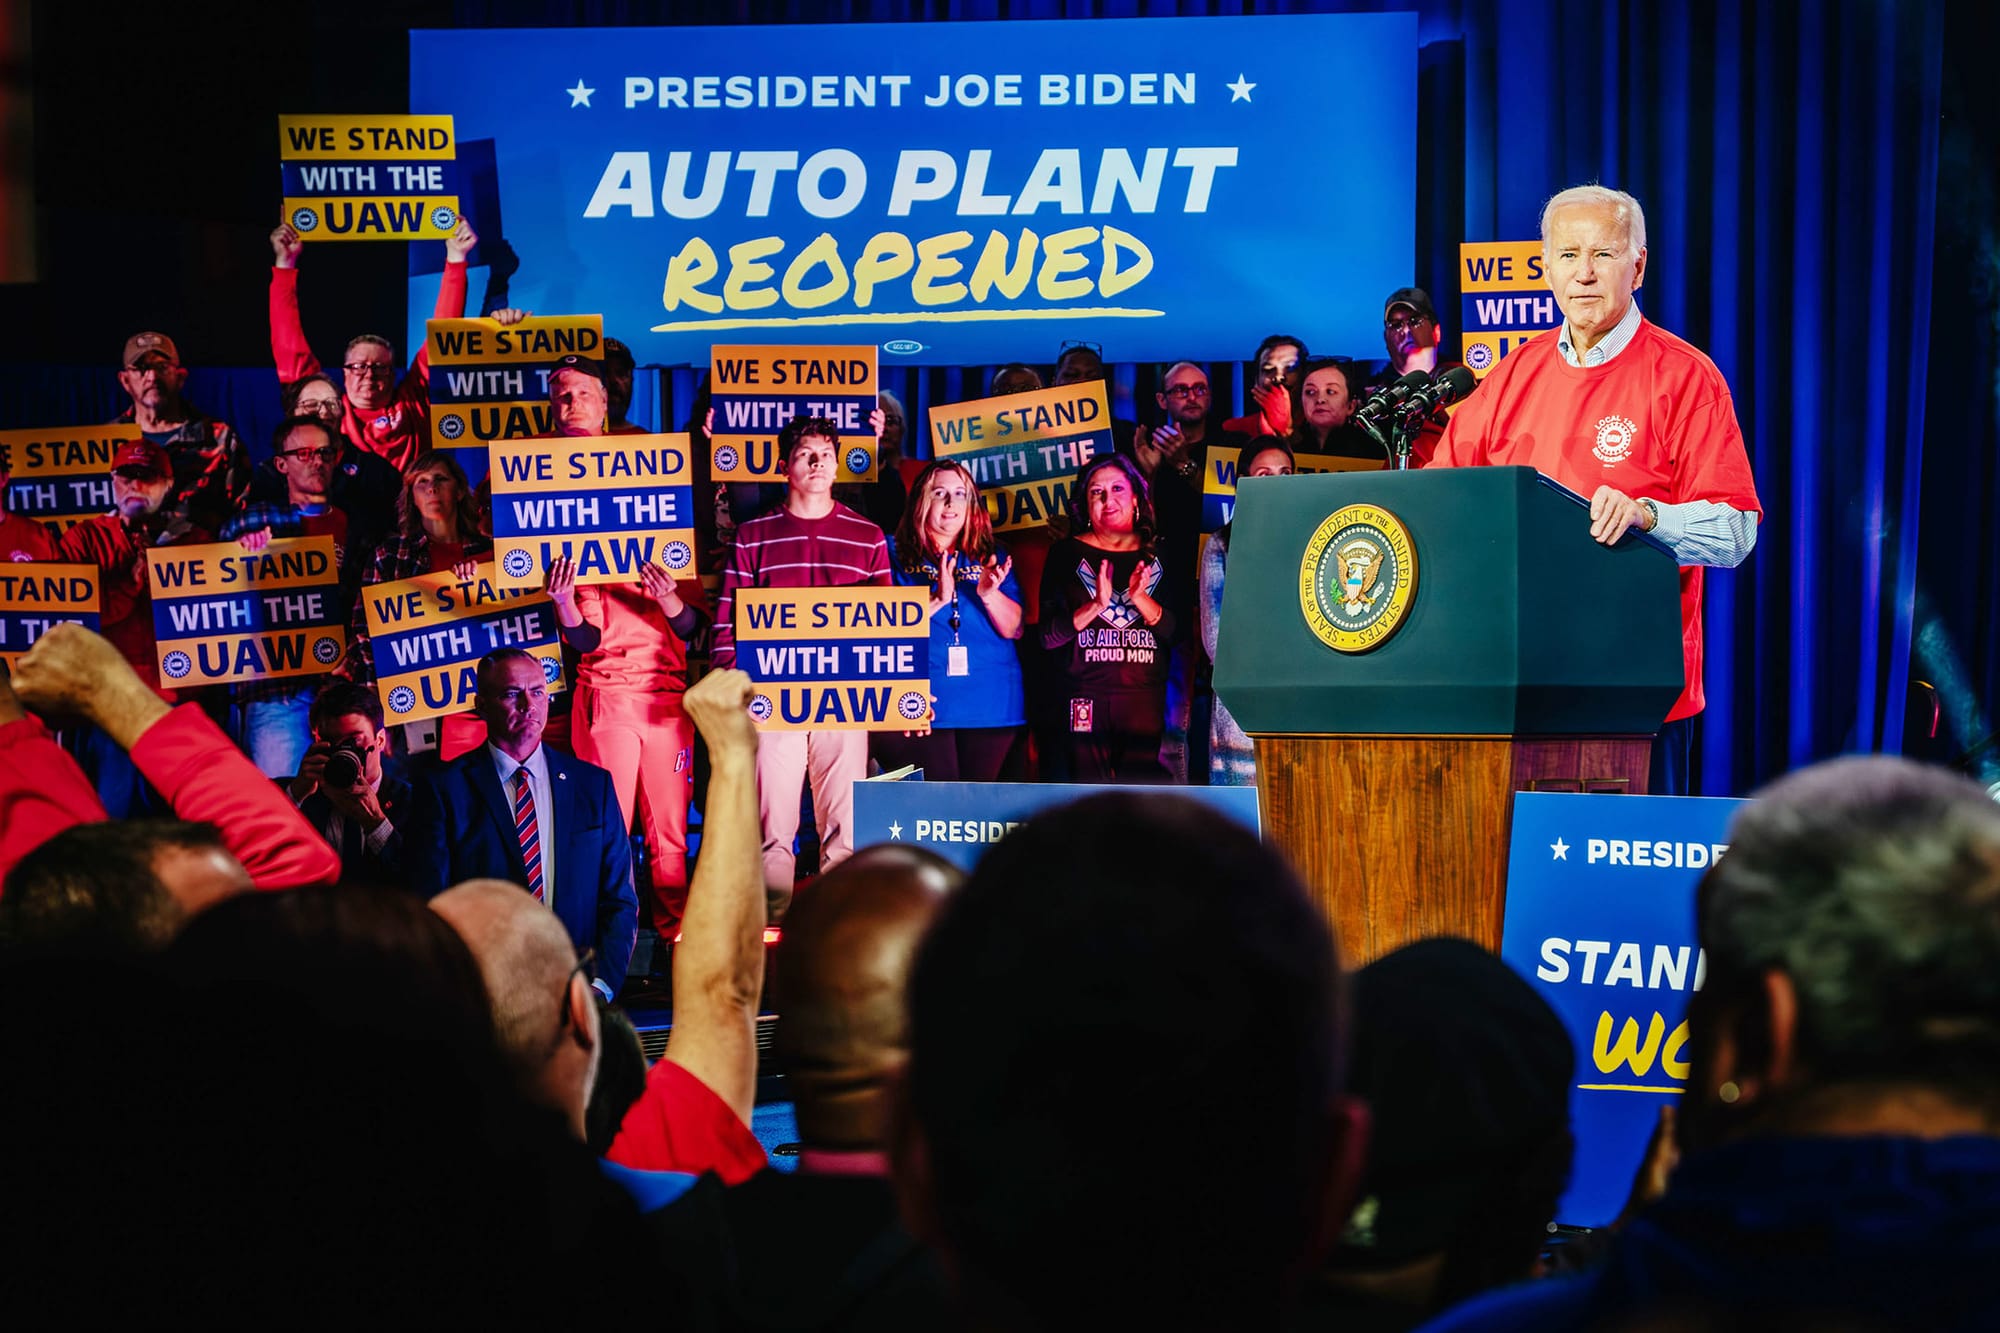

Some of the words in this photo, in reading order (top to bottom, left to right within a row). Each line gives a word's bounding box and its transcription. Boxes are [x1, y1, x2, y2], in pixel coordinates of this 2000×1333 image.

[625, 75, 911, 108] PRESIDENT
[924, 74, 1023, 106] JOE
[1039, 72, 1196, 105] BIDEN
[288, 127, 336, 151] WE
[348, 127, 449, 151] STAND
[300, 166, 376, 191] WITH
[387, 166, 444, 191] THE
[583, 148, 868, 219] AUTO
[887, 146, 1239, 217] PLANT
[324, 202, 425, 234] UAW
[663, 225, 1154, 314] REOPENED
[1466, 257, 1513, 282] WE
[1476, 297, 1554, 325] WITH
[435, 331, 483, 356] WE
[495, 328, 598, 355] STAND
[446, 370, 524, 397] WITH
[716, 359, 760, 384] WE
[772, 359, 869, 385] STAND
[724, 401, 796, 428] WITH
[807, 402, 860, 429] THE
[936, 415, 984, 445] WE
[995, 397, 1099, 437] STAND
[499, 454, 553, 482] WE
[568, 448, 685, 479] STAND
[1038, 439, 1095, 472] THE
[1216, 460, 1235, 486] W
[8, 483, 57, 511] ITH
[512, 497, 600, 529] WITH
[613, 494, 677, 525] THE
[1375, 515, 1389, 529] THE
[1305, 509, 1361, 571] PRESIDENT
[155, 560, 206, 588] WE
[219, 550, 327, 583] STAND
[1389, 529, 1409, 589] UNITED
[0, 576, 94, 603] TAND
[1304, 577, 1313, 597] THE
[169, 599, 252, 632] WITH
[264, 593, 324, 623] THE
[374, 591, 425, 624] WE
[746, 602, 797, 629] WE
[811, 601, 923, 629] STAND
[1078, 629, 1095, 648] US
[1096, 629, 1120, 647] AIR
[1311, 612, 1340, 643] SEAL
[1358, 602, 1400, 645] STATES
[390, 626, 472, 667] WITH
[482, 612, 543, 648] THE
[197, 633, 306, 678] UAW
[756, 646, 839, 675] WITH
[852, 645, 914, 674] THE
[1085, 648, 1125, 662] PROUD
[1127, 649, 1154, 664] MOM
[420, 666, 478, 710] UA
[780, 687, 893, 724] UAW
[916, 820, 1020, 844] PRESID
[1587, 838, 1731, 869] PRESIDE
